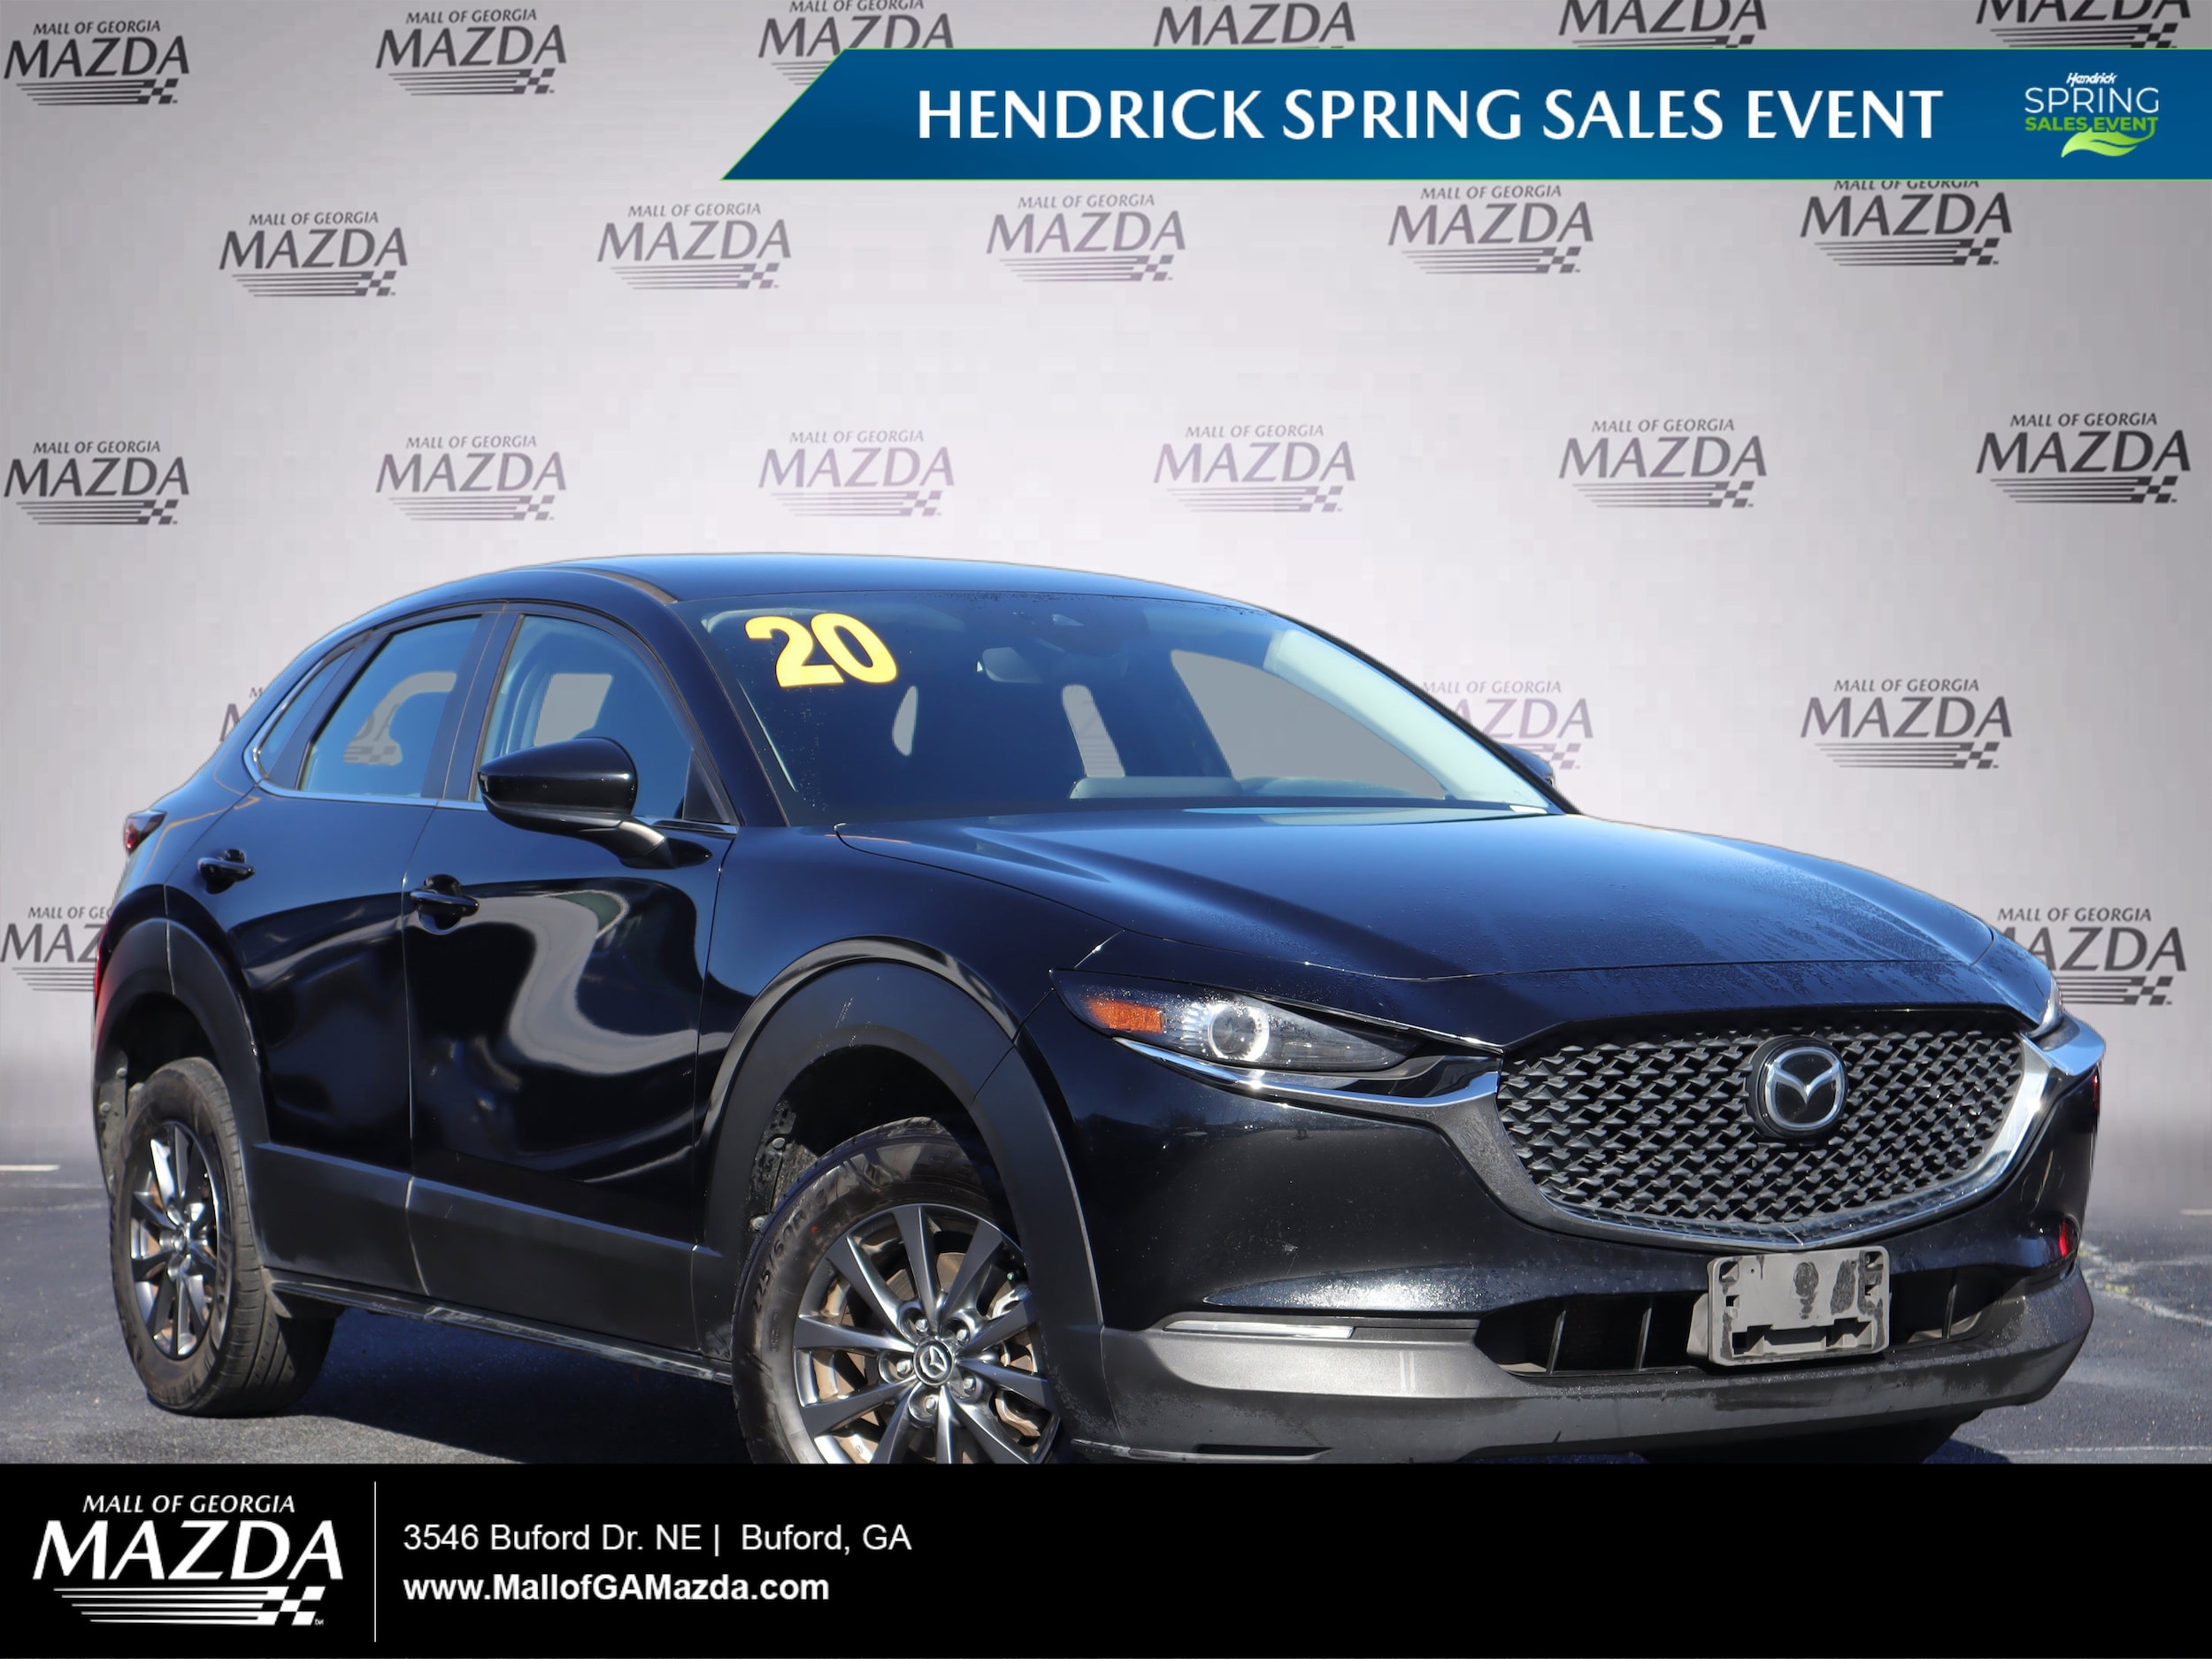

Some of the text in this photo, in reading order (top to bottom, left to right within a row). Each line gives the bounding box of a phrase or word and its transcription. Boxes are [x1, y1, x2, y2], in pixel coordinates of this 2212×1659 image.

[34, 20, 160, 35] MALL OF GEORGIA
[406, 9, 537, 25] MALL OF GEORGIA
[758, 13, 955, 58] MAZDA
[1154, 2, 1356, 47] MAZDA
[1559, 0, 1767, 36] MAZDA
[4, 35, 189, 79] MAZDA
[375, 24, 567, 68] MAZDA
[628, 203, 762, 218] MALL OF GEORGIA
[1018, 194, 1156, 209] MALL OF GEORGIA
[1421, 185, 1563, 200] MALL OF GEORGIA
[249, 211, 379, 227] MALL OF GEORGIA
[986, 211, 1187, 255] MAZDA
[1387, 202, 1594, 247] MAZDA
[1800, 192, 2013, 238] MAZDA
[219, 227, 408, 271] MAZDA
[596, 219, 791, 263] MAZDA
[790, 429, 925, 444] MALL OF GEORGIA
[1186, 425, 1325, 439] MALL OF GEORGIA
[1593, 419, 1735, 433] MALL OF GEORGIA
[2010, 412, 2157, 427] MALL OF GEORGIA
[33, 441, 160, 455] MALL OF GEORGIA
[406, 435, 537, 449] MALL OF GEORGIA
[1558, 435, 1768, 479] MAZDA
[1976, 430, 2192, 474] MAZDA
[4, 457, 189, 497] MAZDA
[375, 452, 567, 493] MAZDA
[757, 447, 955, 488] MAZDA
[1153, 441, 1356, 484] MAZDA
[744, 612, 898, 687] 20
[1467, 681, 1486, 694] OF
[1492, 680, 1562, 694] GEORGIA
[1834, 678, 1980, 693] MALL OF GEORGIA
[1801, 696, 2013, 739] MAZDA
[28, 907, 63, 919] MALL
[67, 907, 85, 918] OF
[1998, 907, 2152, 922] MALL OF GEORGIA
[0, 923, 105, 963] MAZ
[2006, 926, 2187, 972] AZDA
